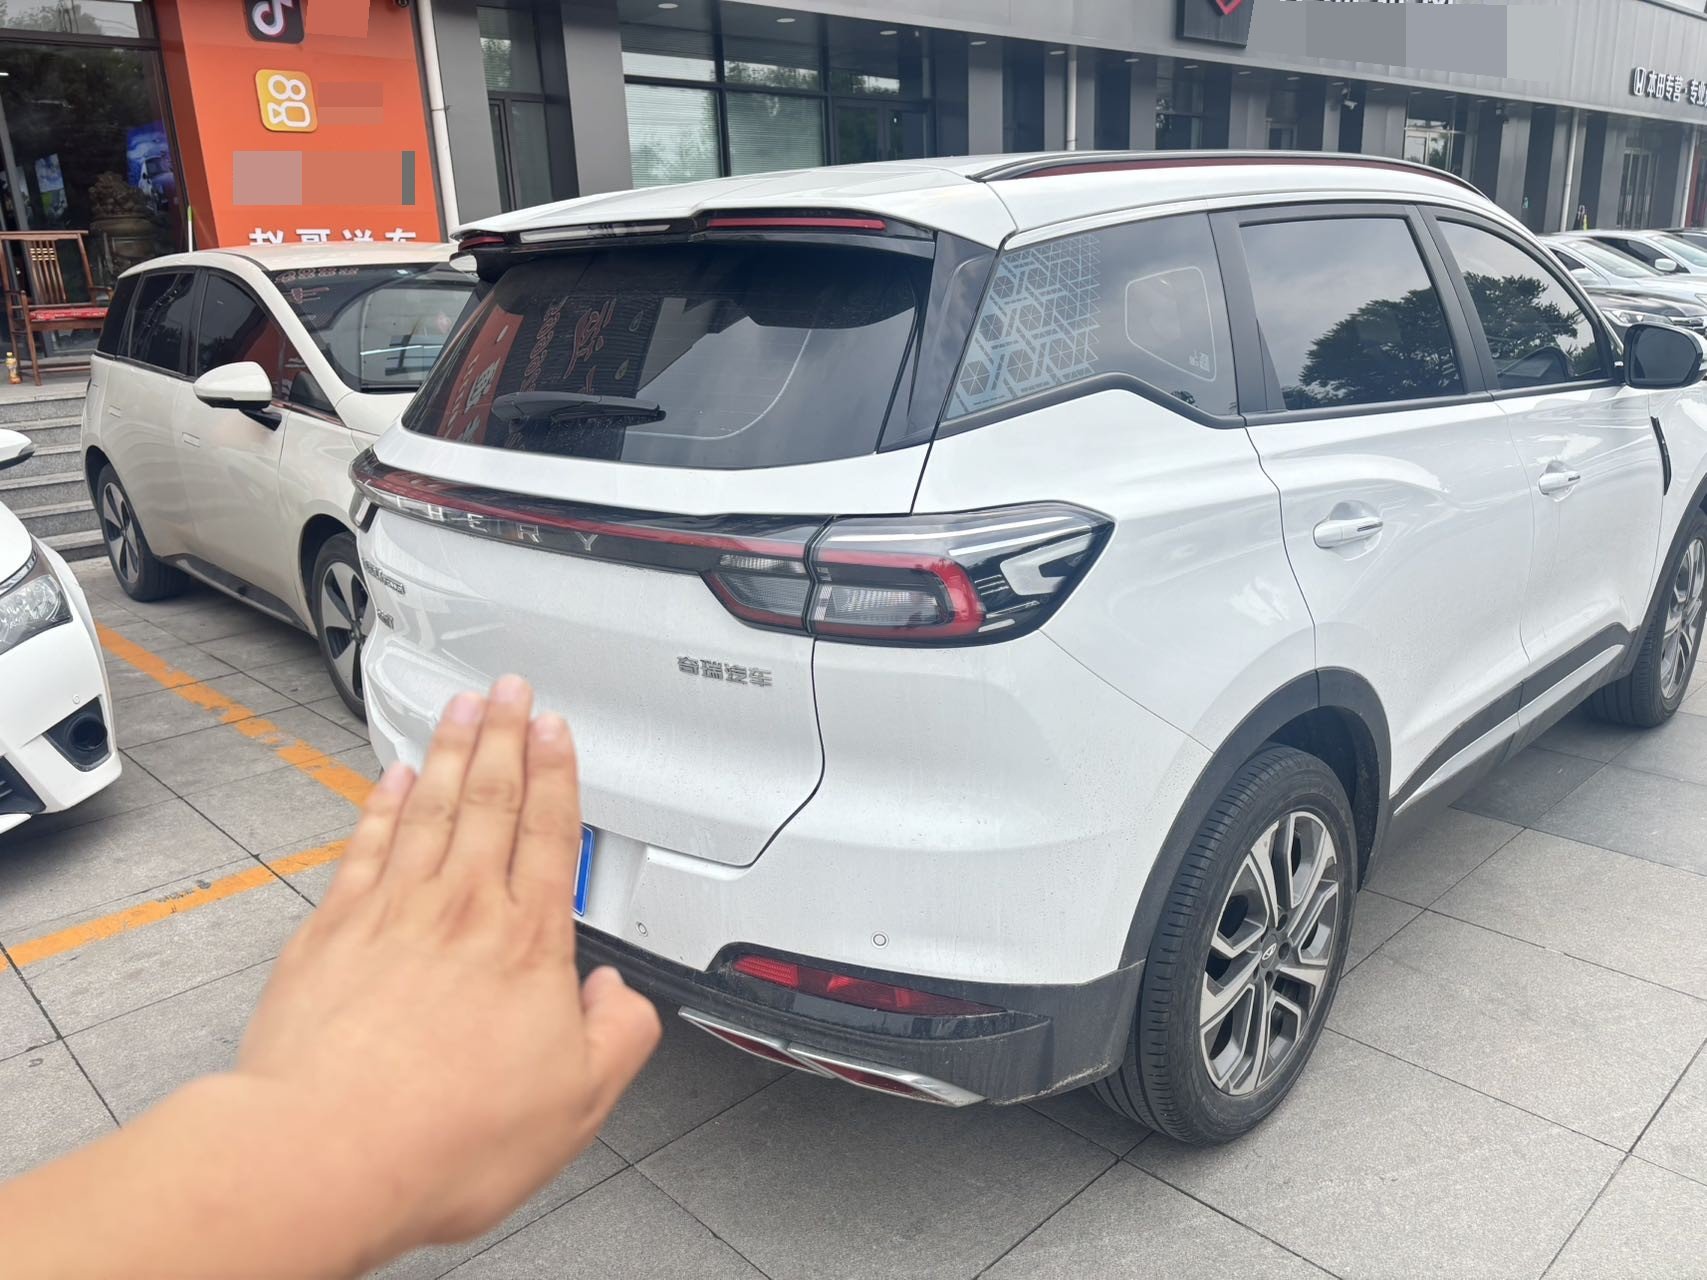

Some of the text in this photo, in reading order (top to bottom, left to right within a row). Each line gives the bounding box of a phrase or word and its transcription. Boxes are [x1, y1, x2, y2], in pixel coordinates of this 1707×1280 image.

[1646, 69, 1707, 107] 本田专营·专业
[677, 656, 773, 687] 奇瑞汽车
